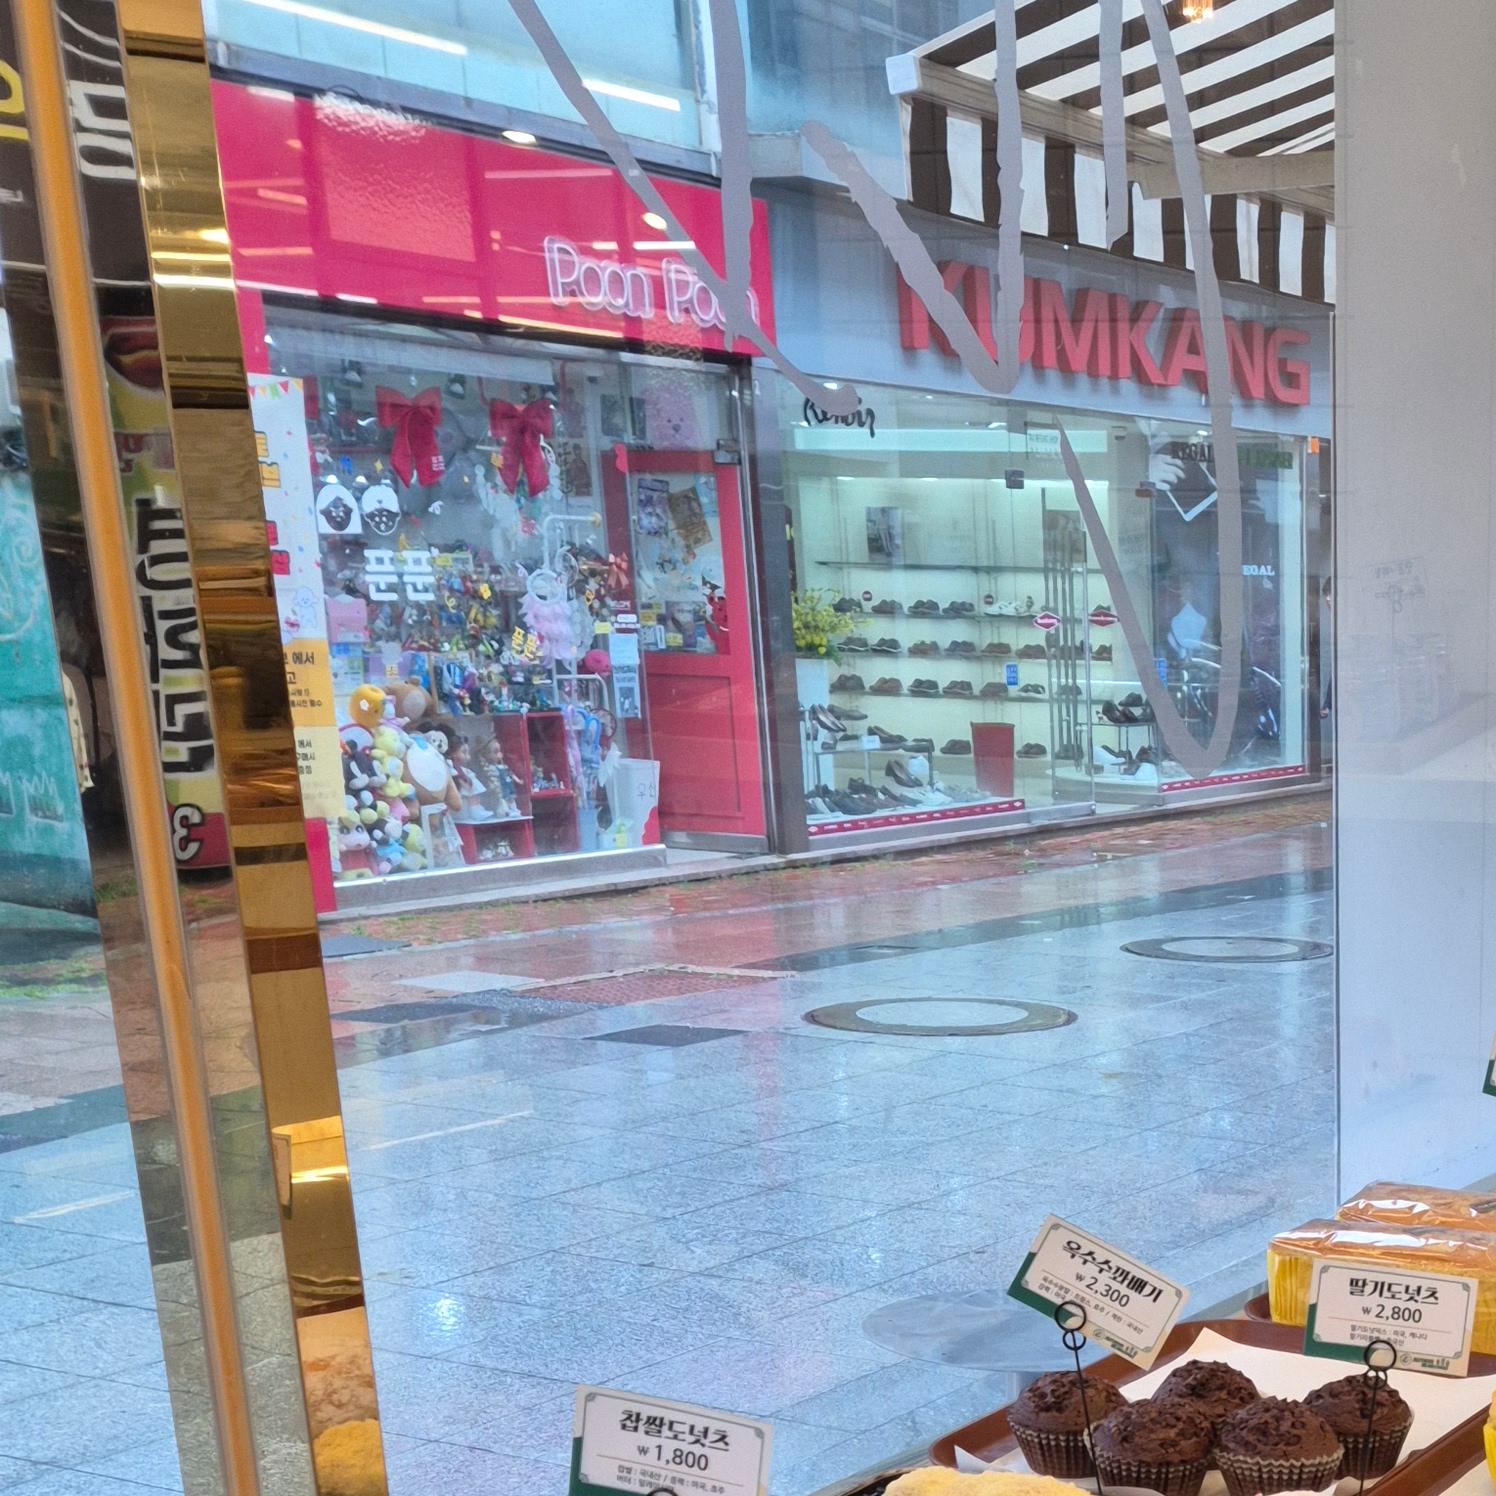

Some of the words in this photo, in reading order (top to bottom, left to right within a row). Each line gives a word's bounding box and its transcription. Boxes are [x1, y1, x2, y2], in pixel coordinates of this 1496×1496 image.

[544, 235, 654, 320] Poon
[661, 256, 760, 330] Po
[897, 259, 1311, 406] KUMKANG
[1242, 564, 1275, 577] EGAL
[1062, 1240, 1164, 1303] 옥수수꽈배기
[1085, 1276, 1130, 1308] 2,300
[1349, 1277, 1439, 1305] 딸기도넛츠
[1375, 1304, 1422, 1323] 2,800
[619, 1409, 731, 1452] 찹쌀도넛츠
[654, 1445, 708, 1471] 1,800
